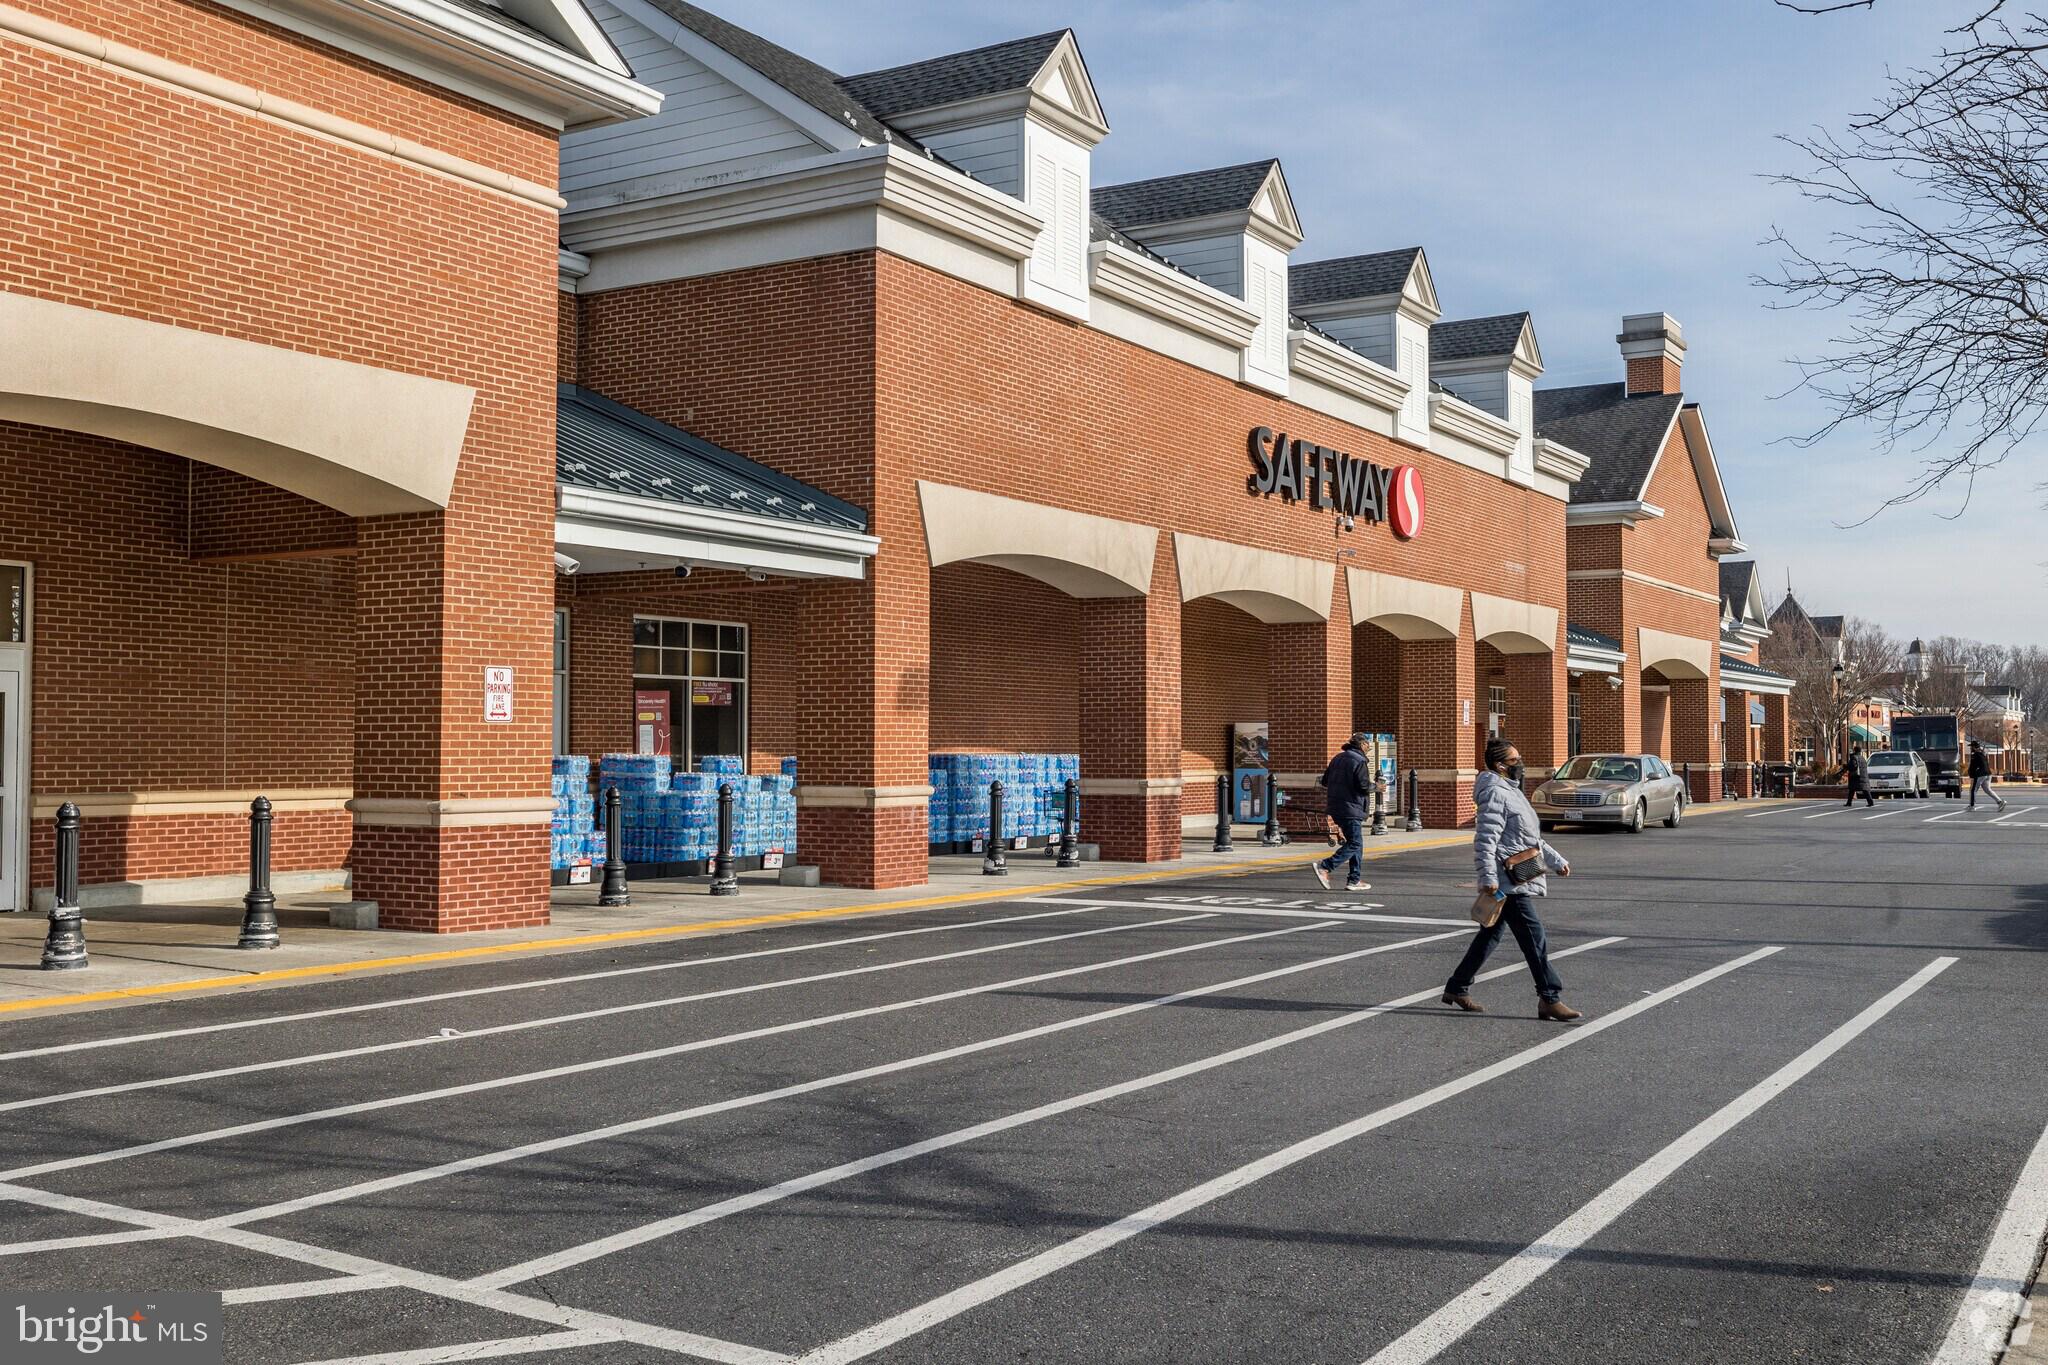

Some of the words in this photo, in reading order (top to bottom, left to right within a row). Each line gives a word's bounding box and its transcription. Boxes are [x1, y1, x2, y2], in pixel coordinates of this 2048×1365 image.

[1249, 426, 1393, 521] SAFEWAY
[493, 671, 504, 681] NO
[487, 683, 511, 694] PARKING
[493, 694, 504, 702] FIRE
[492, 703, 505, 711] LANE
[1144, 895, 1385, 911] STOP
